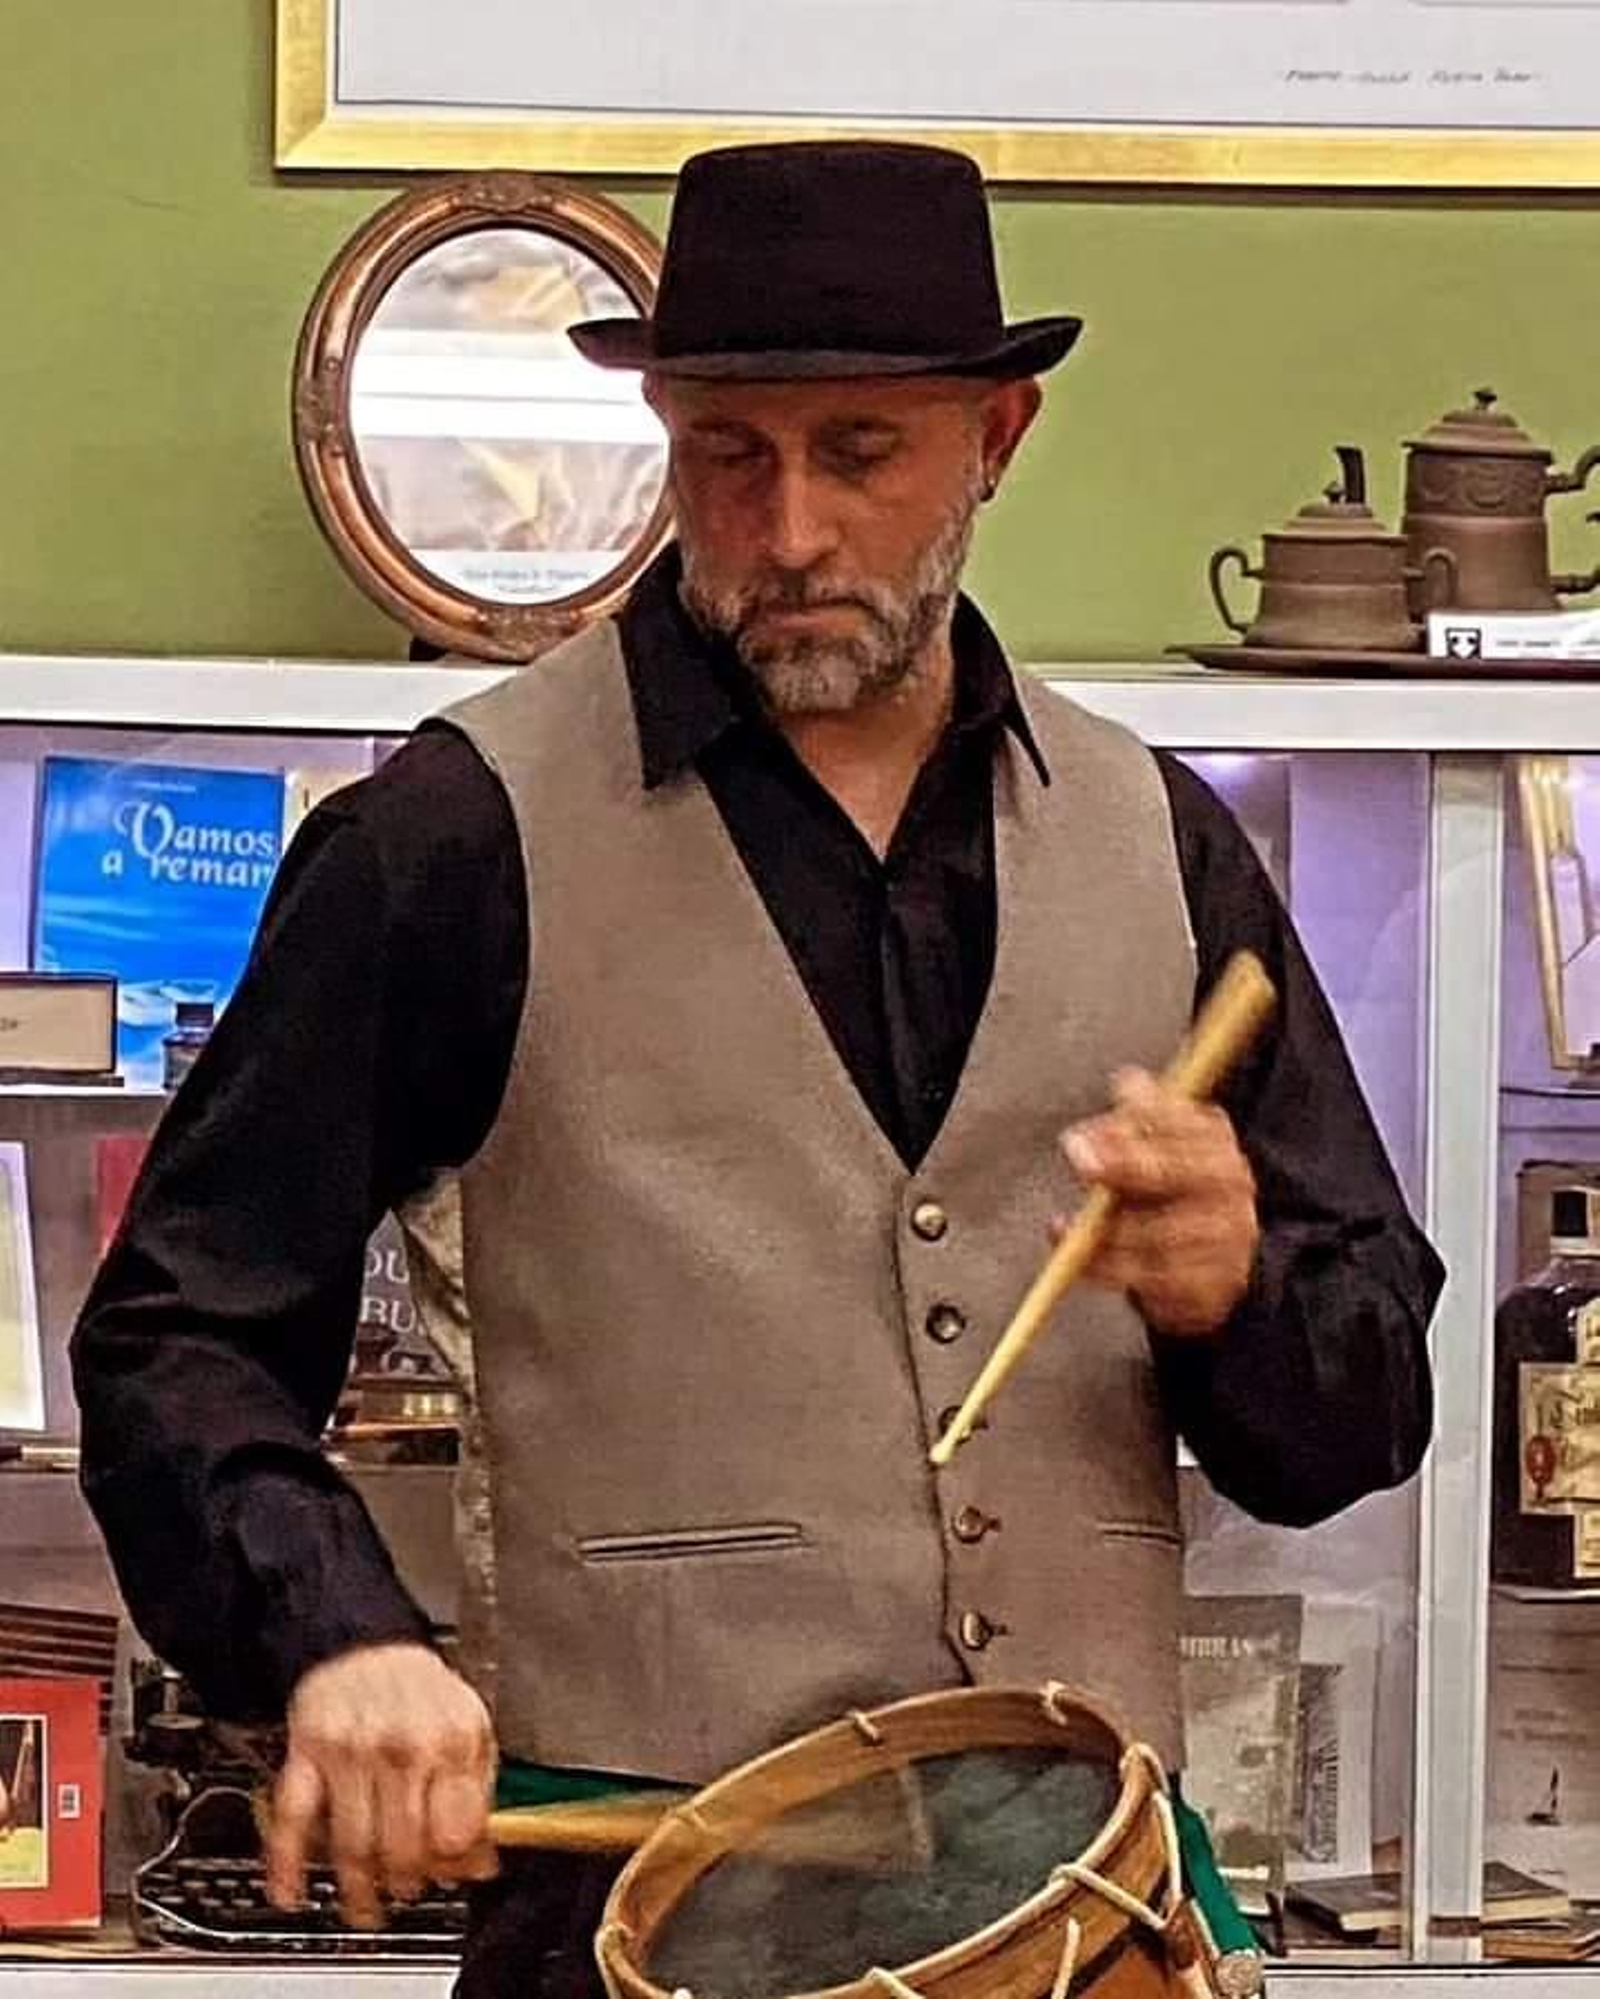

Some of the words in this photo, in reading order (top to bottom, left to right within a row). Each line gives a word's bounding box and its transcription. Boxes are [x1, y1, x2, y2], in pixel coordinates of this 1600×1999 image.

[113, 801, 275, 859] Vamos
[102, 850, 124, 877] a
[150, 853, 272, 888] remar
